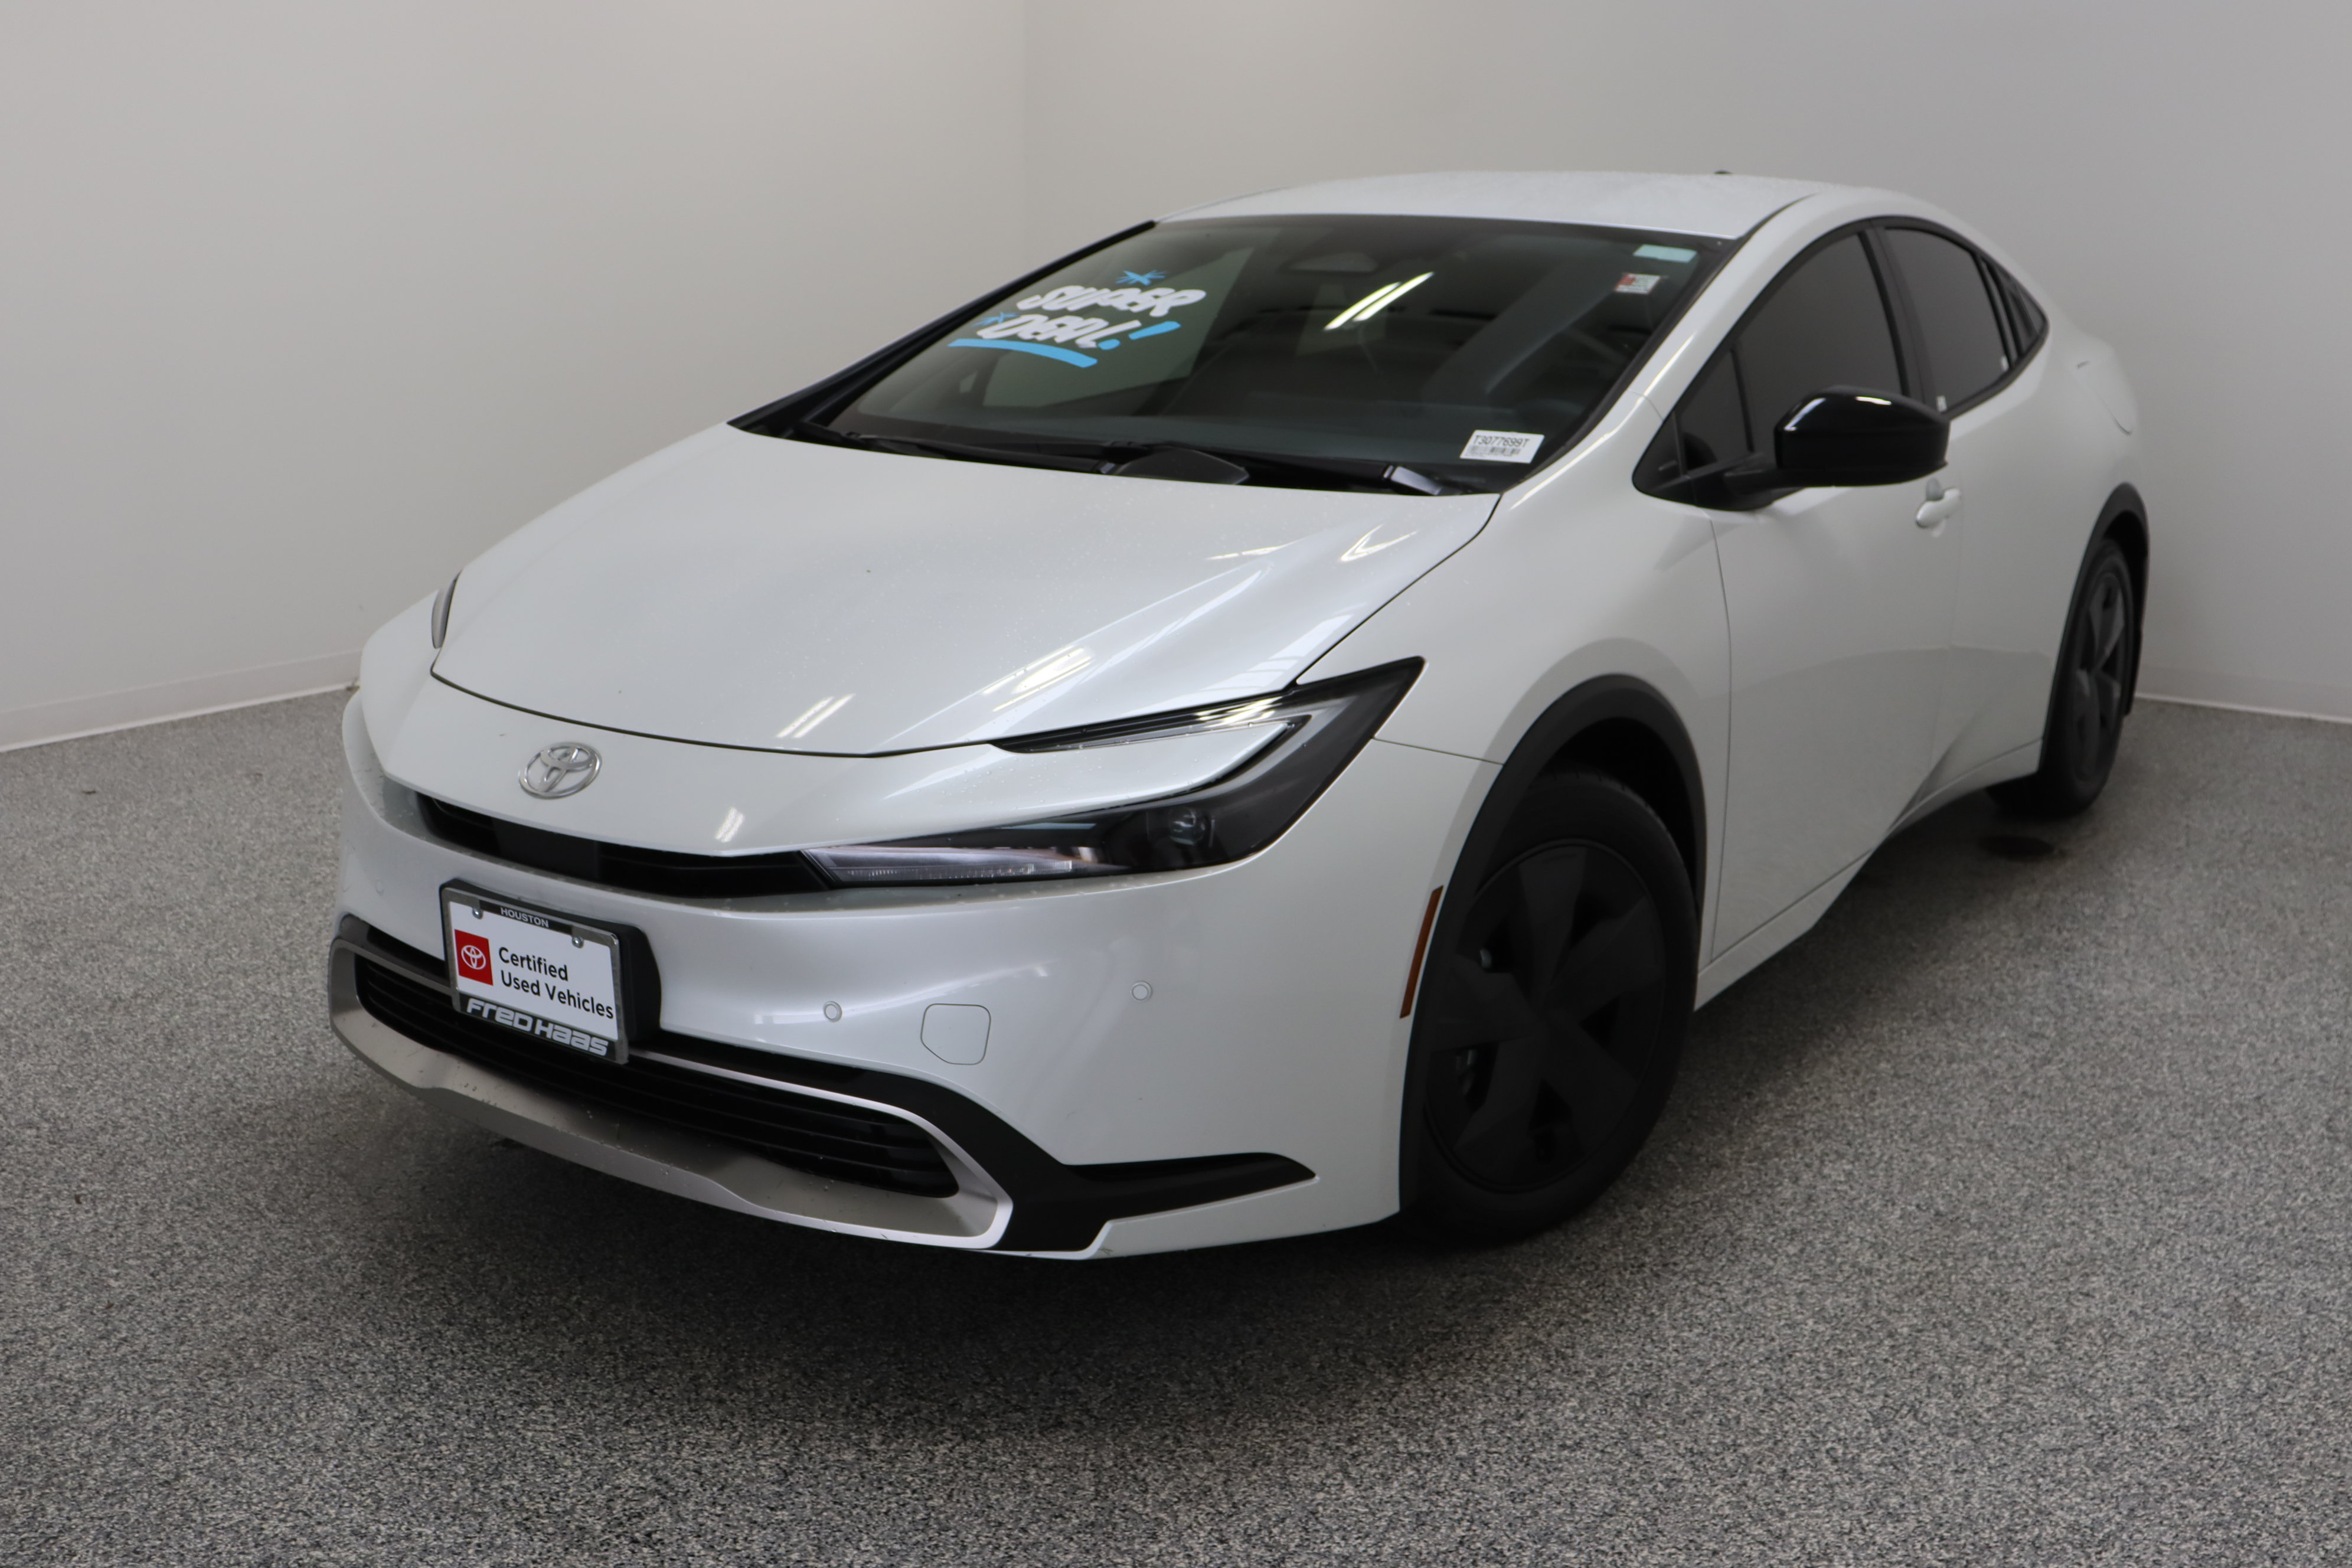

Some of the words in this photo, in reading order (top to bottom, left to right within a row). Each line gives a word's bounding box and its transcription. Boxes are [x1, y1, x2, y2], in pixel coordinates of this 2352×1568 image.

[1016, 285, 1206, 317] SUPER
[501, 907, 549, 928] HOUSTON
[499, 947, 569, 981] Certified
[501, 970, 540, 996] Used
[545, 984, 613, 1019] Vehicles
